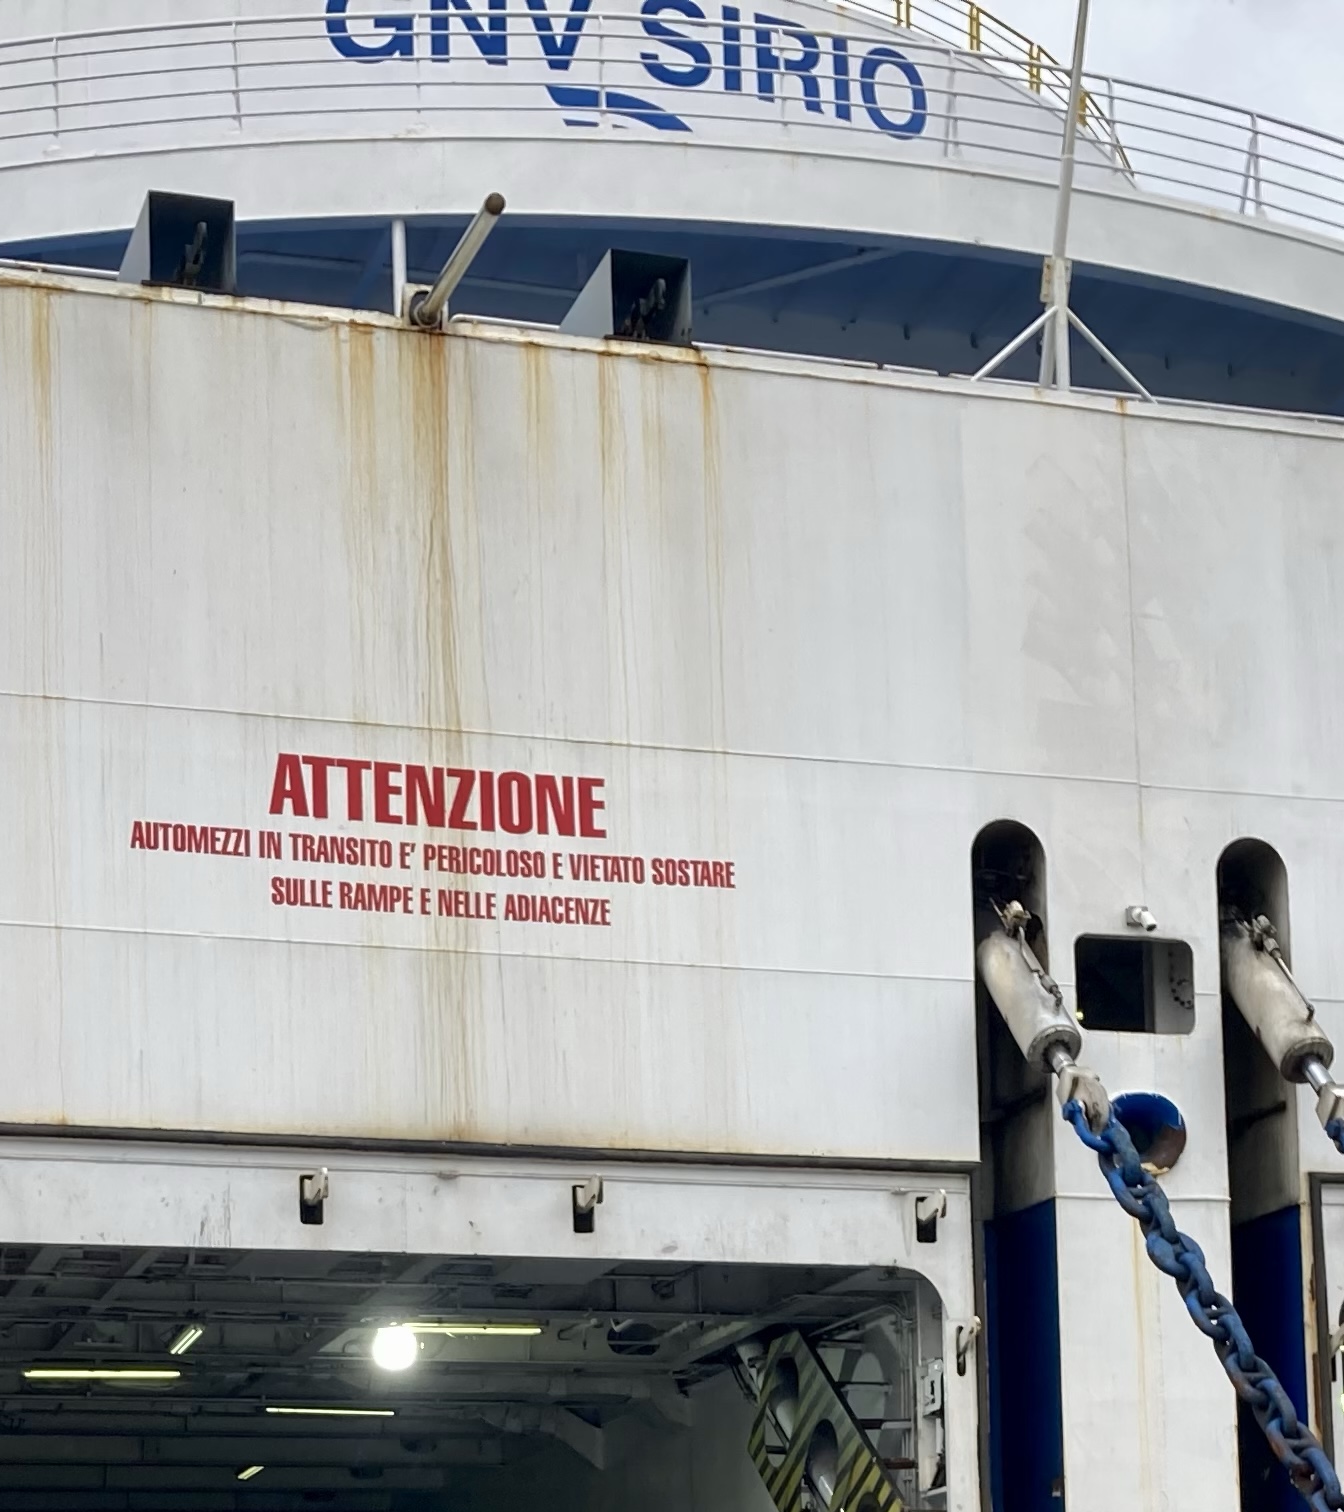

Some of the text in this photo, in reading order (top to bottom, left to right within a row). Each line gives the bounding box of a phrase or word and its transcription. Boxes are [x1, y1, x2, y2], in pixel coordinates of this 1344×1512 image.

[325, 0, 928, 140] GNV SIRIO
[268, 752, 607, 839] ATTENZIONE
[130, 820, 251, 857] AUTOMEZZI
[258, 831, 282, 860] IN
[288, 832, 393, 869] TRANSITO
[422, 842, 546, 879] PERICOLOSO
[551, 852, 563, 880] E
[568, 854, 645, 884] VIETATO
[650, 858, 735, 889] SOSTARE
[270, 876, 611, 926] SULLE RAMPE E NELLE ADIACENZE
